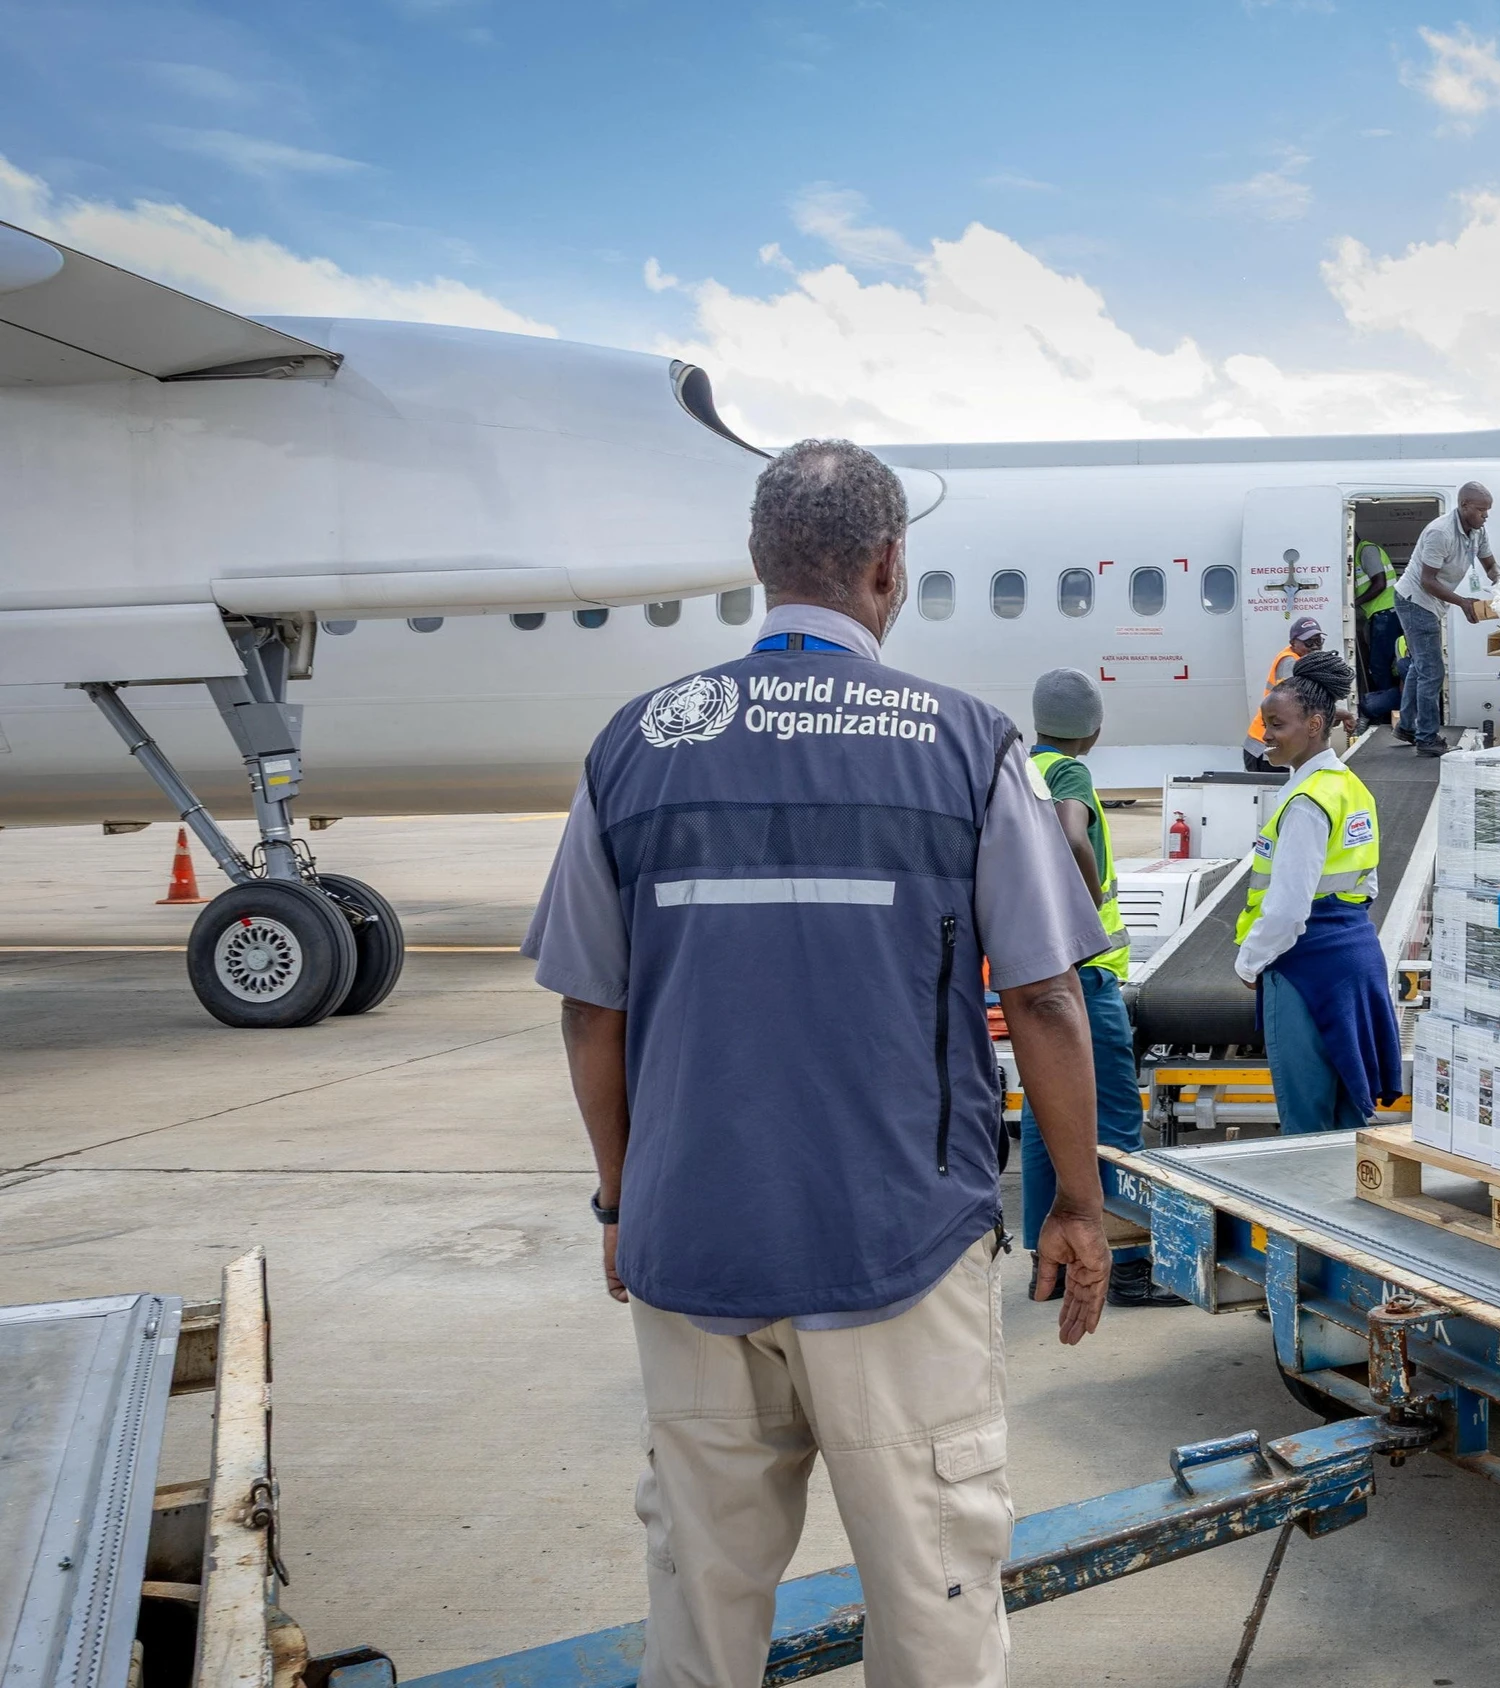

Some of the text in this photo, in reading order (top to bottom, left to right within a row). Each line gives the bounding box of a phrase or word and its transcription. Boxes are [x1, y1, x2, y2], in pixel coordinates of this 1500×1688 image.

[1250, 565, 1331, 575] EMERGECY EXIT
[749, 676, 939, 715] World Health
[745, 704, 936, 743] Organization
[1360, 1164, 1377, 1186] EPAL
